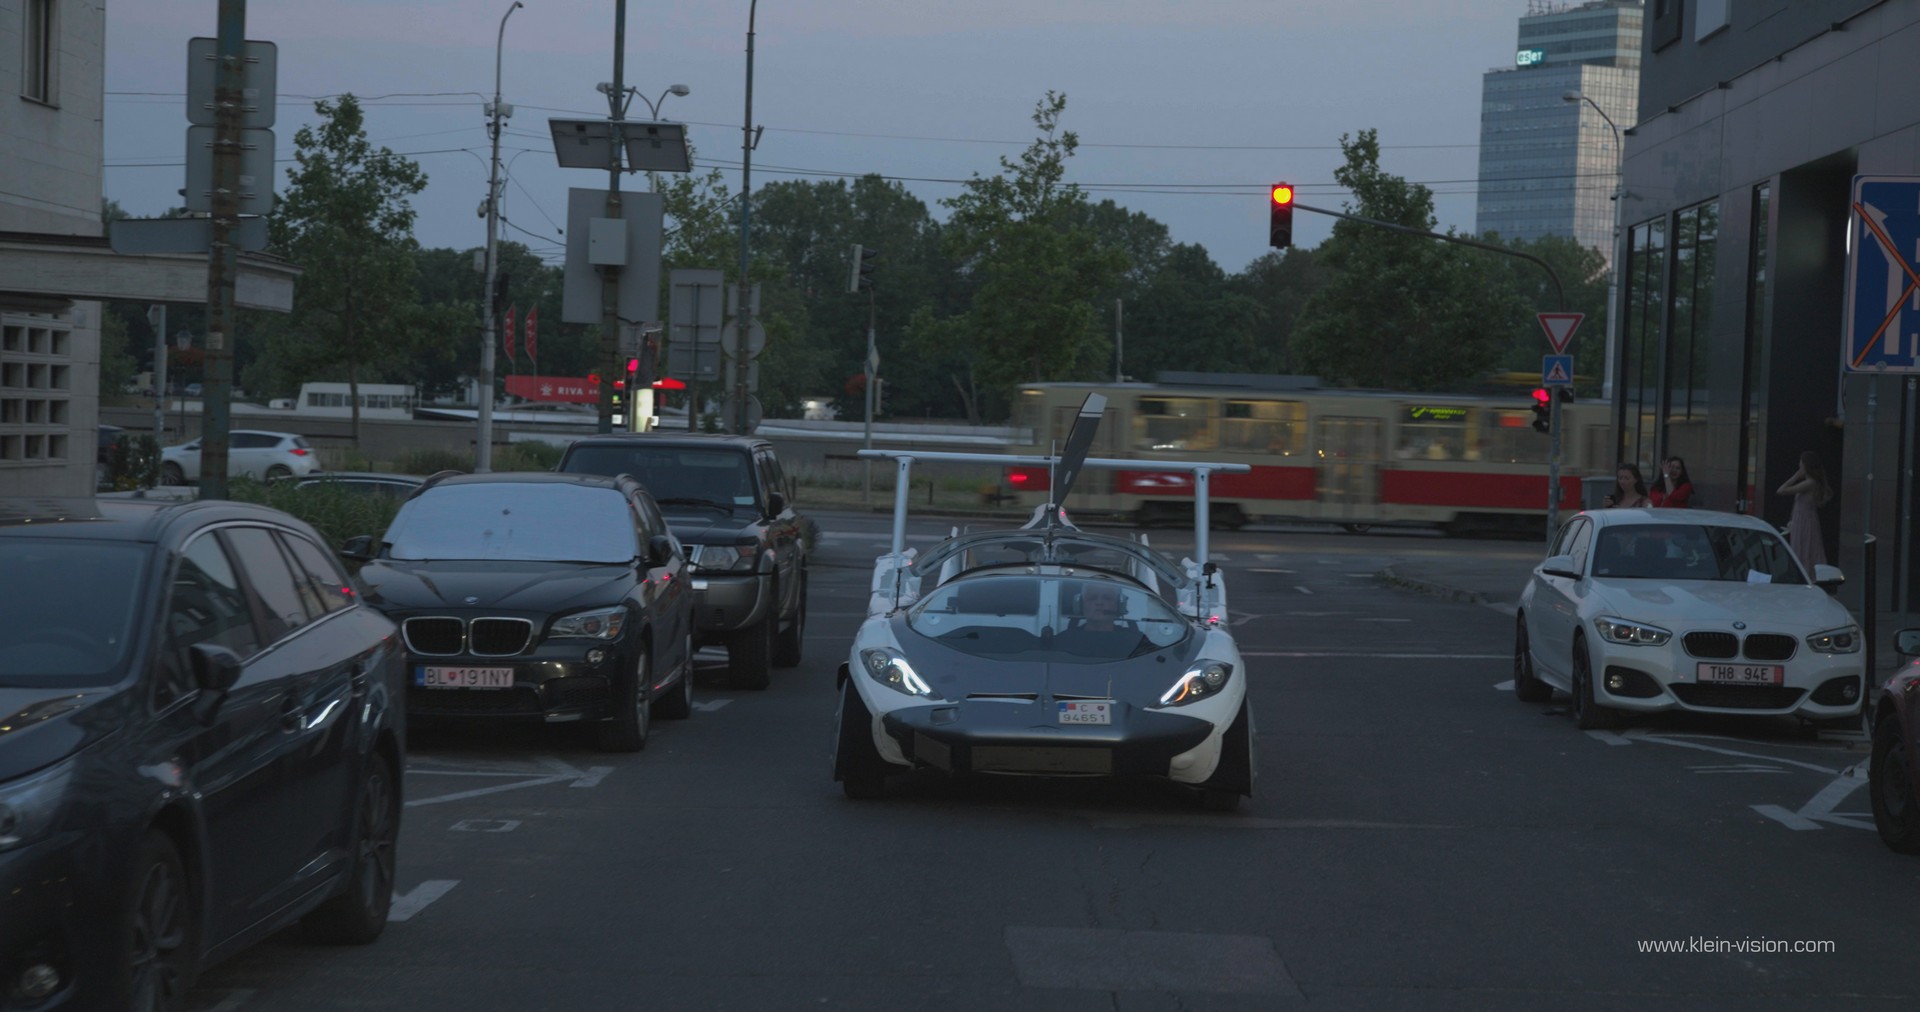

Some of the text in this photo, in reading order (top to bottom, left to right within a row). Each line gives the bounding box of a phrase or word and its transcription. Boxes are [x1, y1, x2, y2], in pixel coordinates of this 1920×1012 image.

[557, 386, 584, 395] RIVA
[426, 668, 511, 686] BL 191NY
[1744, 667, 1769, 681] 94E
[1080, 704, 1089, 713] C
[1063, 713, 1105, 722] 94651
